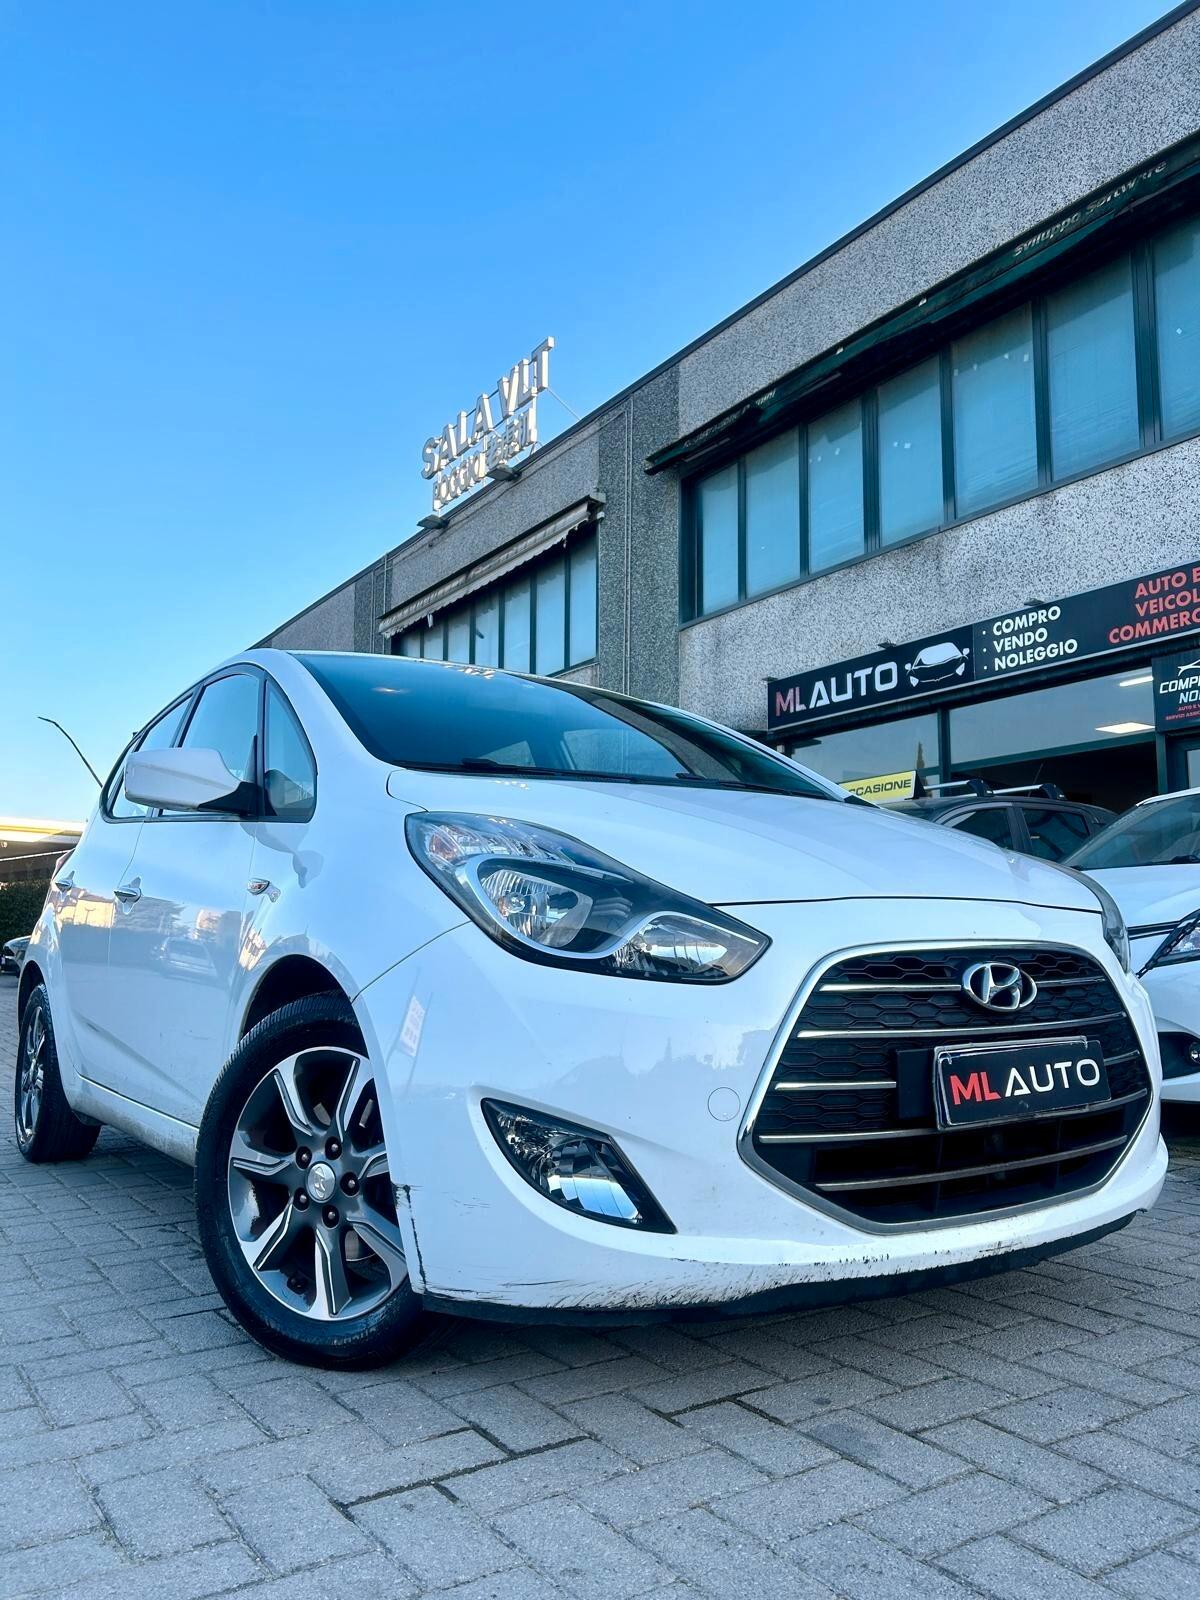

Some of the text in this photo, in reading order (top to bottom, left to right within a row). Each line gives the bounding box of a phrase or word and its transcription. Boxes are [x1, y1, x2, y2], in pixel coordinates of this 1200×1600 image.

[421, 393, 495, 480] SALA
[497, 336, 555, 418] VLT
[1135, 567, 1200, 599] AUTO E
[993, 605, 1061, 636] COMPRO
[993, 627, 1048, 653] VENDO
[994, 638, 1078, 671] NOLEGGIO
[1160, 675, 1200, 694] COMP
